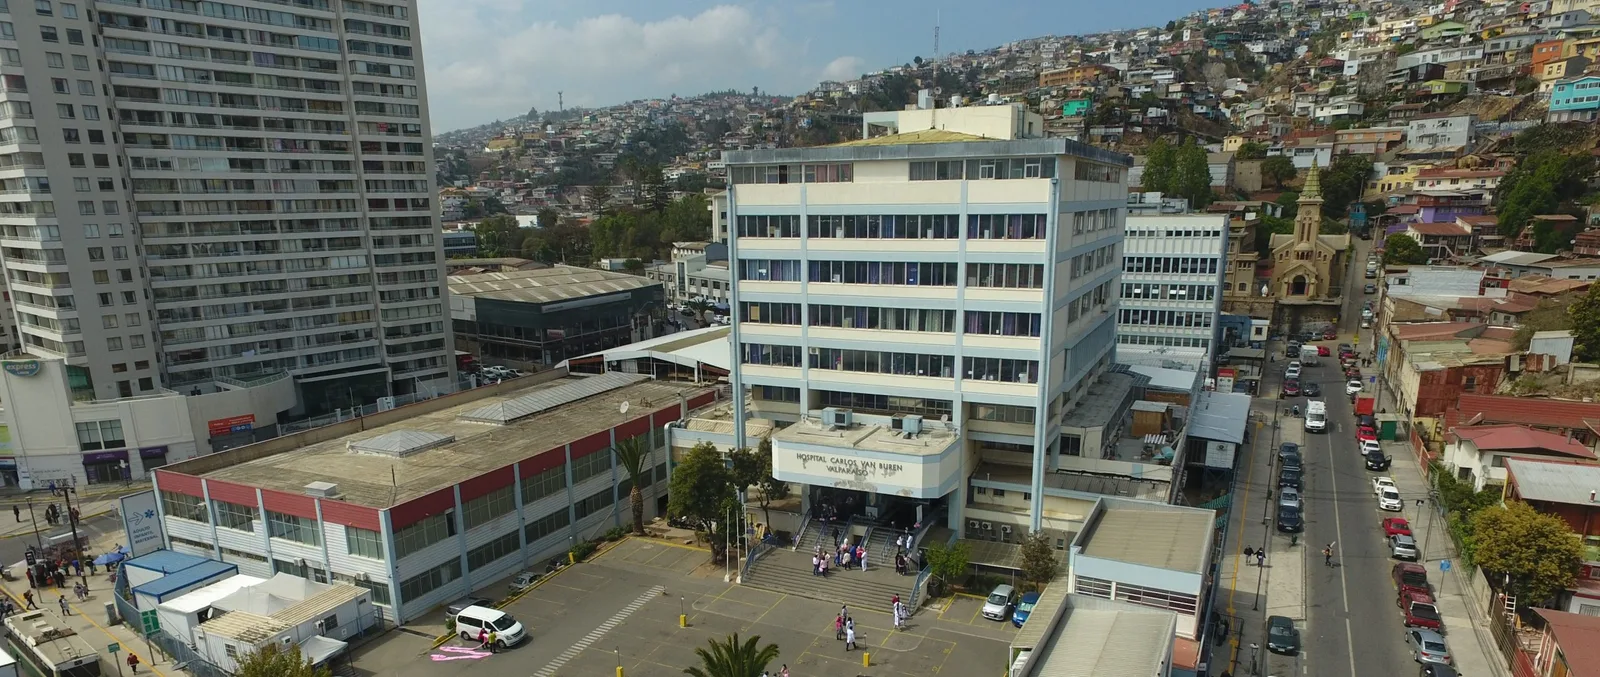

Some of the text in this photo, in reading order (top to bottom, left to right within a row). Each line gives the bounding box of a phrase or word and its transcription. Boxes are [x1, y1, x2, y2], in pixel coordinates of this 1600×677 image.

[6, 363, 37, 371] express
[796, 453, 903, 472] HOSPITAL CARLOS VAN BUREN
[133, 525, 150, 534] ADULTO
